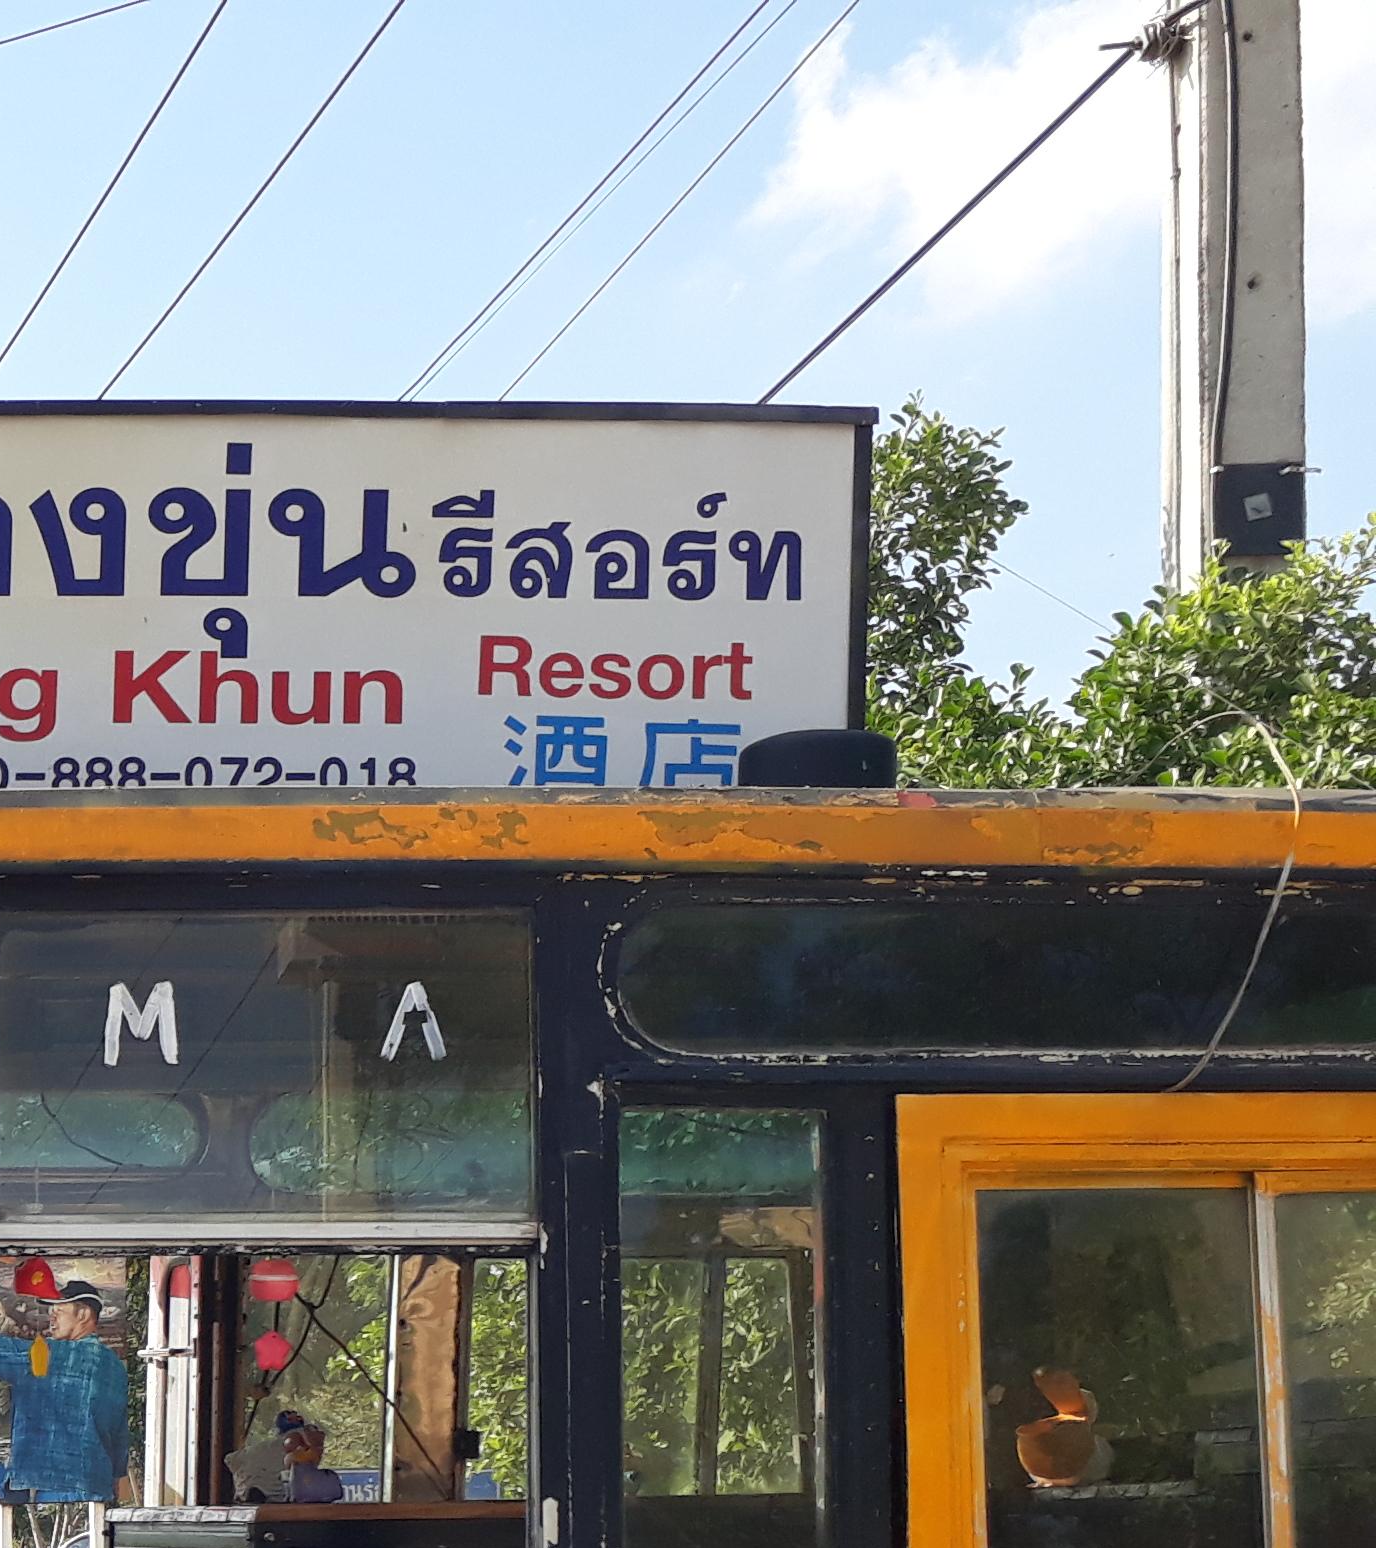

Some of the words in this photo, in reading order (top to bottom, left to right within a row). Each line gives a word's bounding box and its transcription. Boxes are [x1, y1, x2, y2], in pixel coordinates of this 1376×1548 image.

[431, 489, 803, 600] รีสอร์ท
[111, 649, 404, 725] Khun
[477, 635, 754, 700] Resort
[504, 715, 741, 786] 酒店
